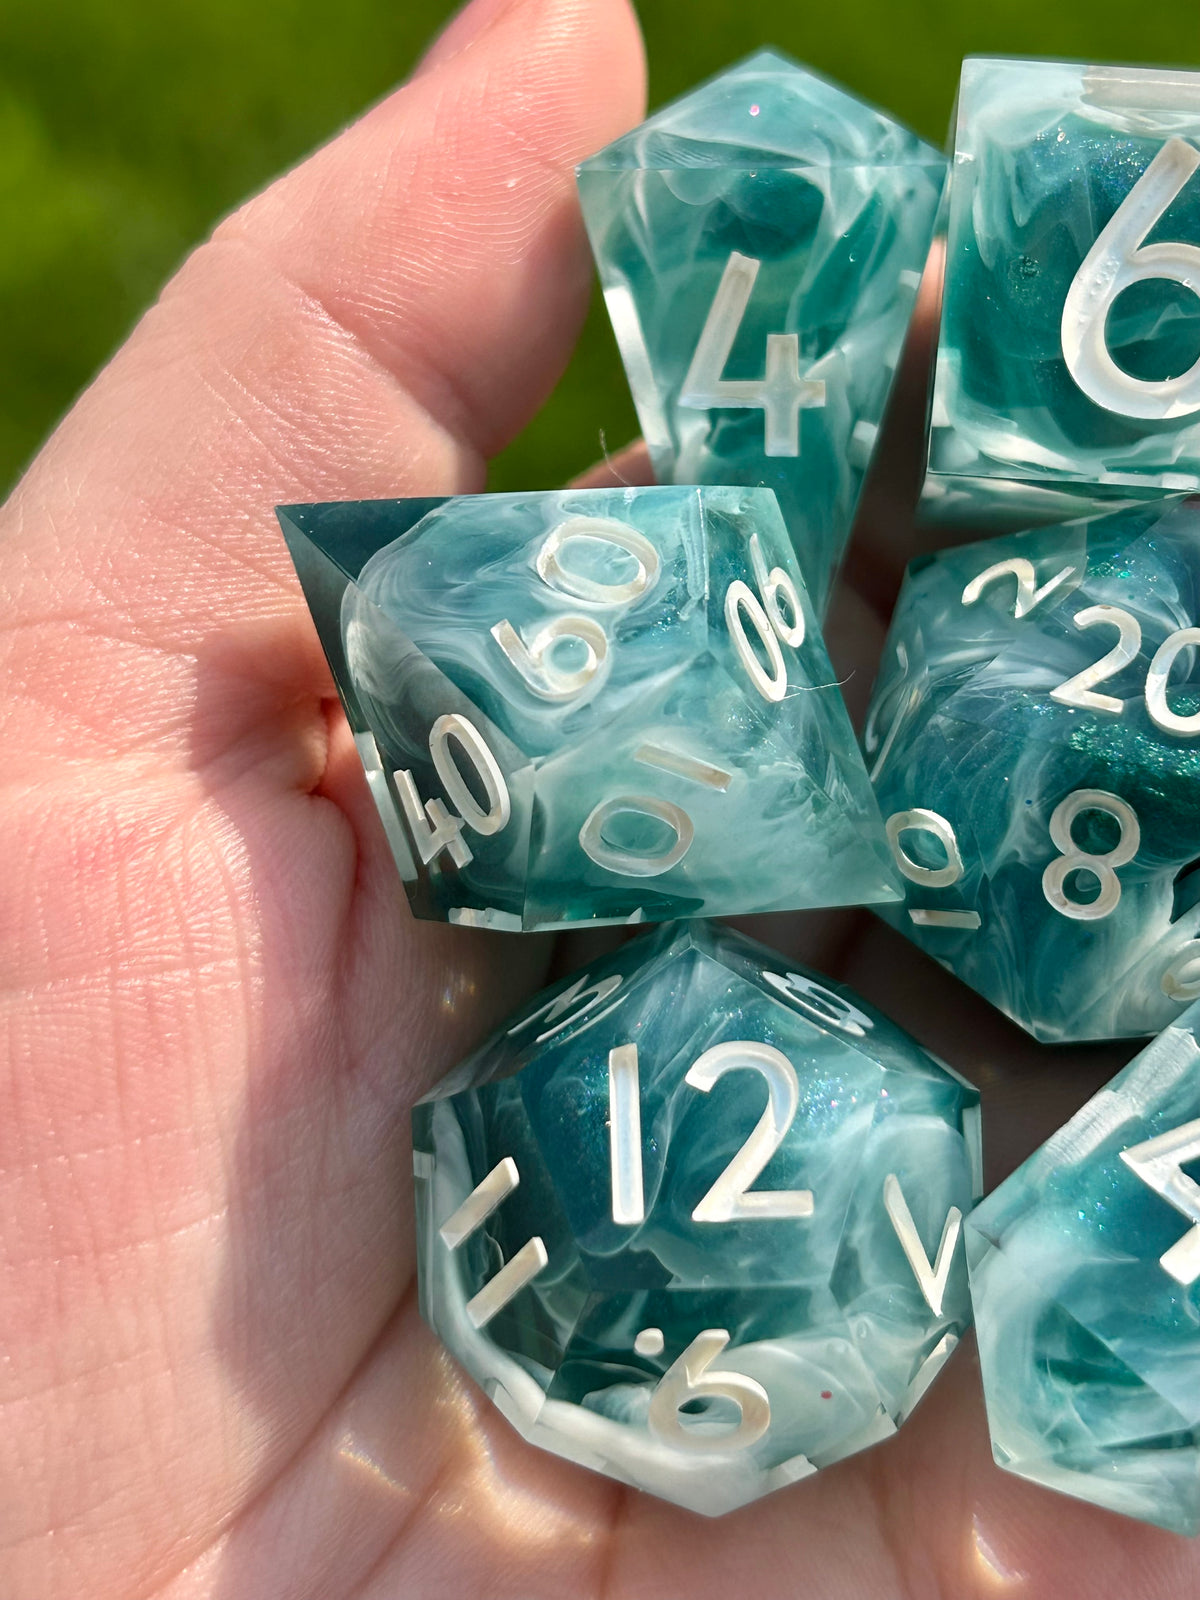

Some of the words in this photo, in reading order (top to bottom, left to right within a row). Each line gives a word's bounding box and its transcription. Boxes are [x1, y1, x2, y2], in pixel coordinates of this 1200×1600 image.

[678, 251, 827, 457] 4
[1061, 137, 1200, 421] 6
[962, 557, 1077, 619] 2
[1049, 605, 1200, 738] 20
[393, 713, 512, 870] 40
[1042, 788, 1141, 921] 8
[609, 1040, 814, 1225] 12
